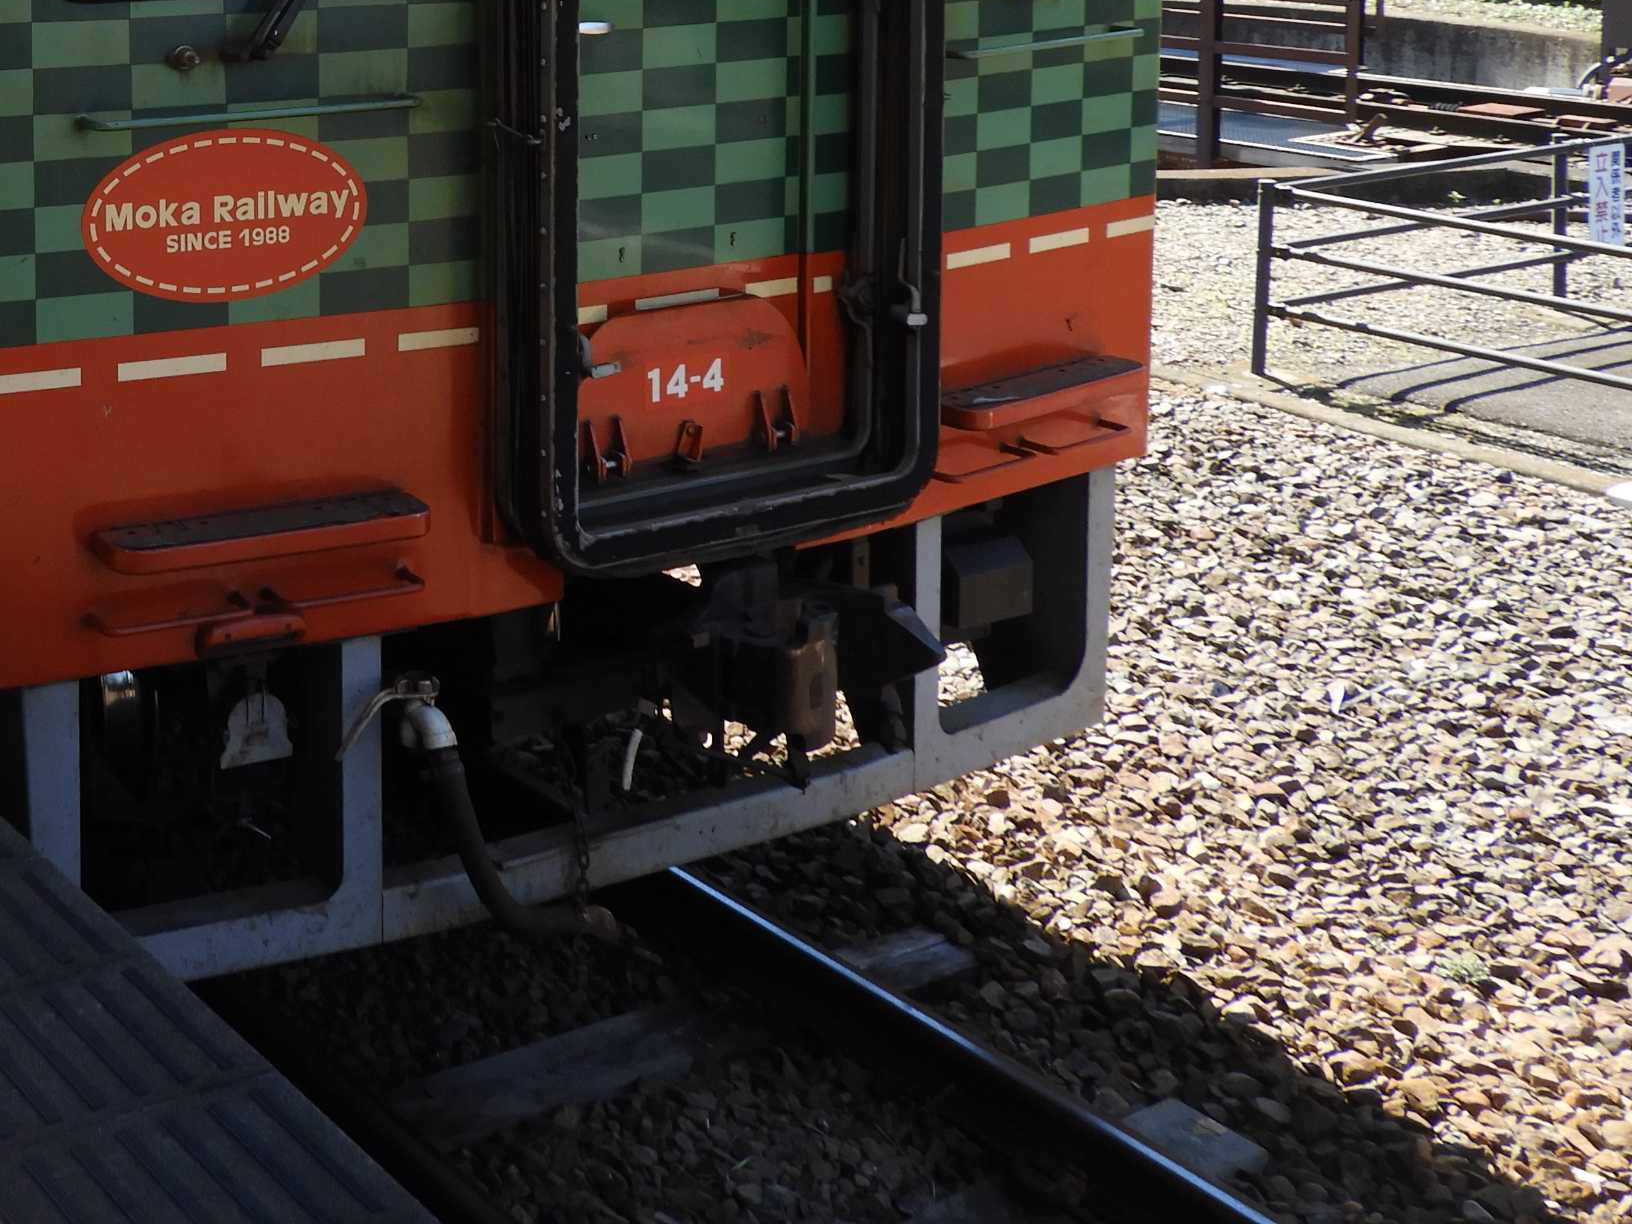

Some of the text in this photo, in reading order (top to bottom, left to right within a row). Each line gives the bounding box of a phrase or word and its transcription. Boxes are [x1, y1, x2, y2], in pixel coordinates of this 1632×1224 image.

[105, 188, 349, 232] Moka Railway
[166, 226, 290, 253] SINCE 1988
[647, 358, 724, 403] 14-4
